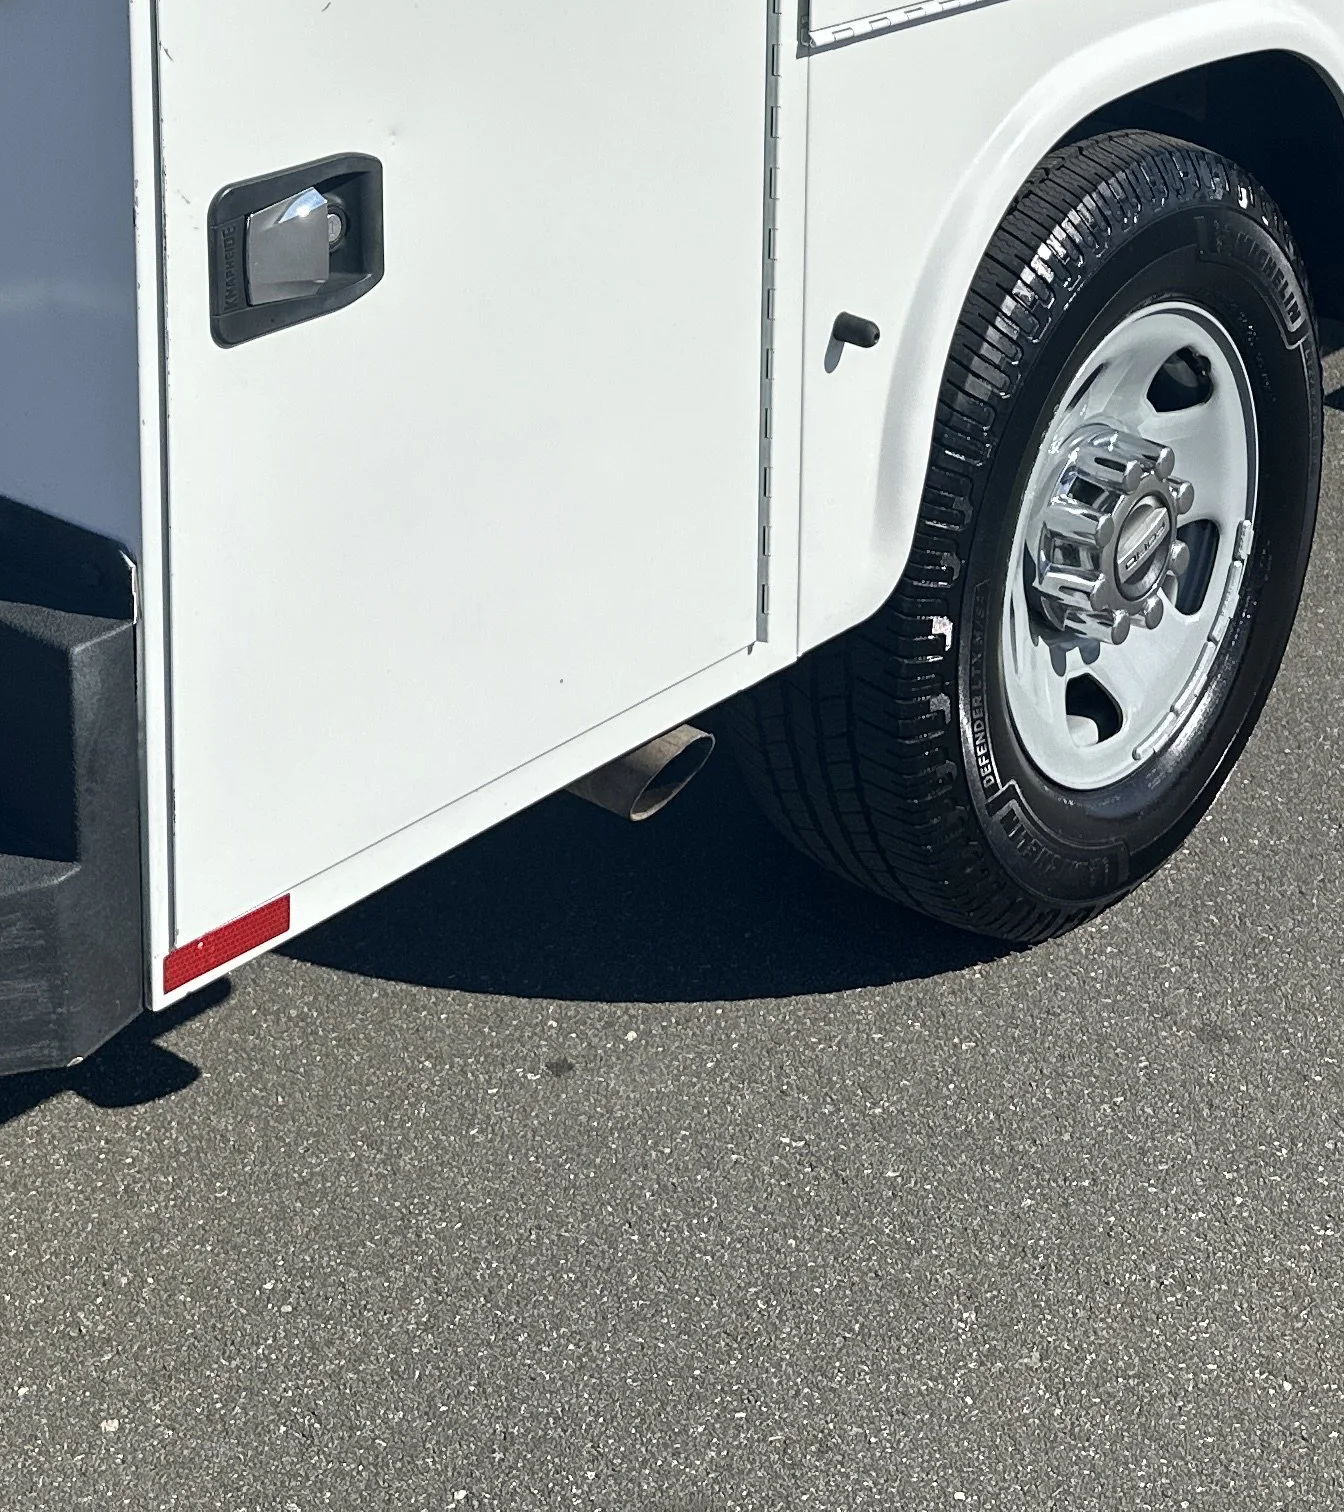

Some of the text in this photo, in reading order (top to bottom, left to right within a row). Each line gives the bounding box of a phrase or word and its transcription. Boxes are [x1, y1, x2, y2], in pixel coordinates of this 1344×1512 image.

[223, 224, 238, 311] KNAPHEIDE
[1235, 230, 1304, 330] MICHELIN
[971, 651, 983, 689] LTX
[972, 695, 995, 788] DEFENDER
